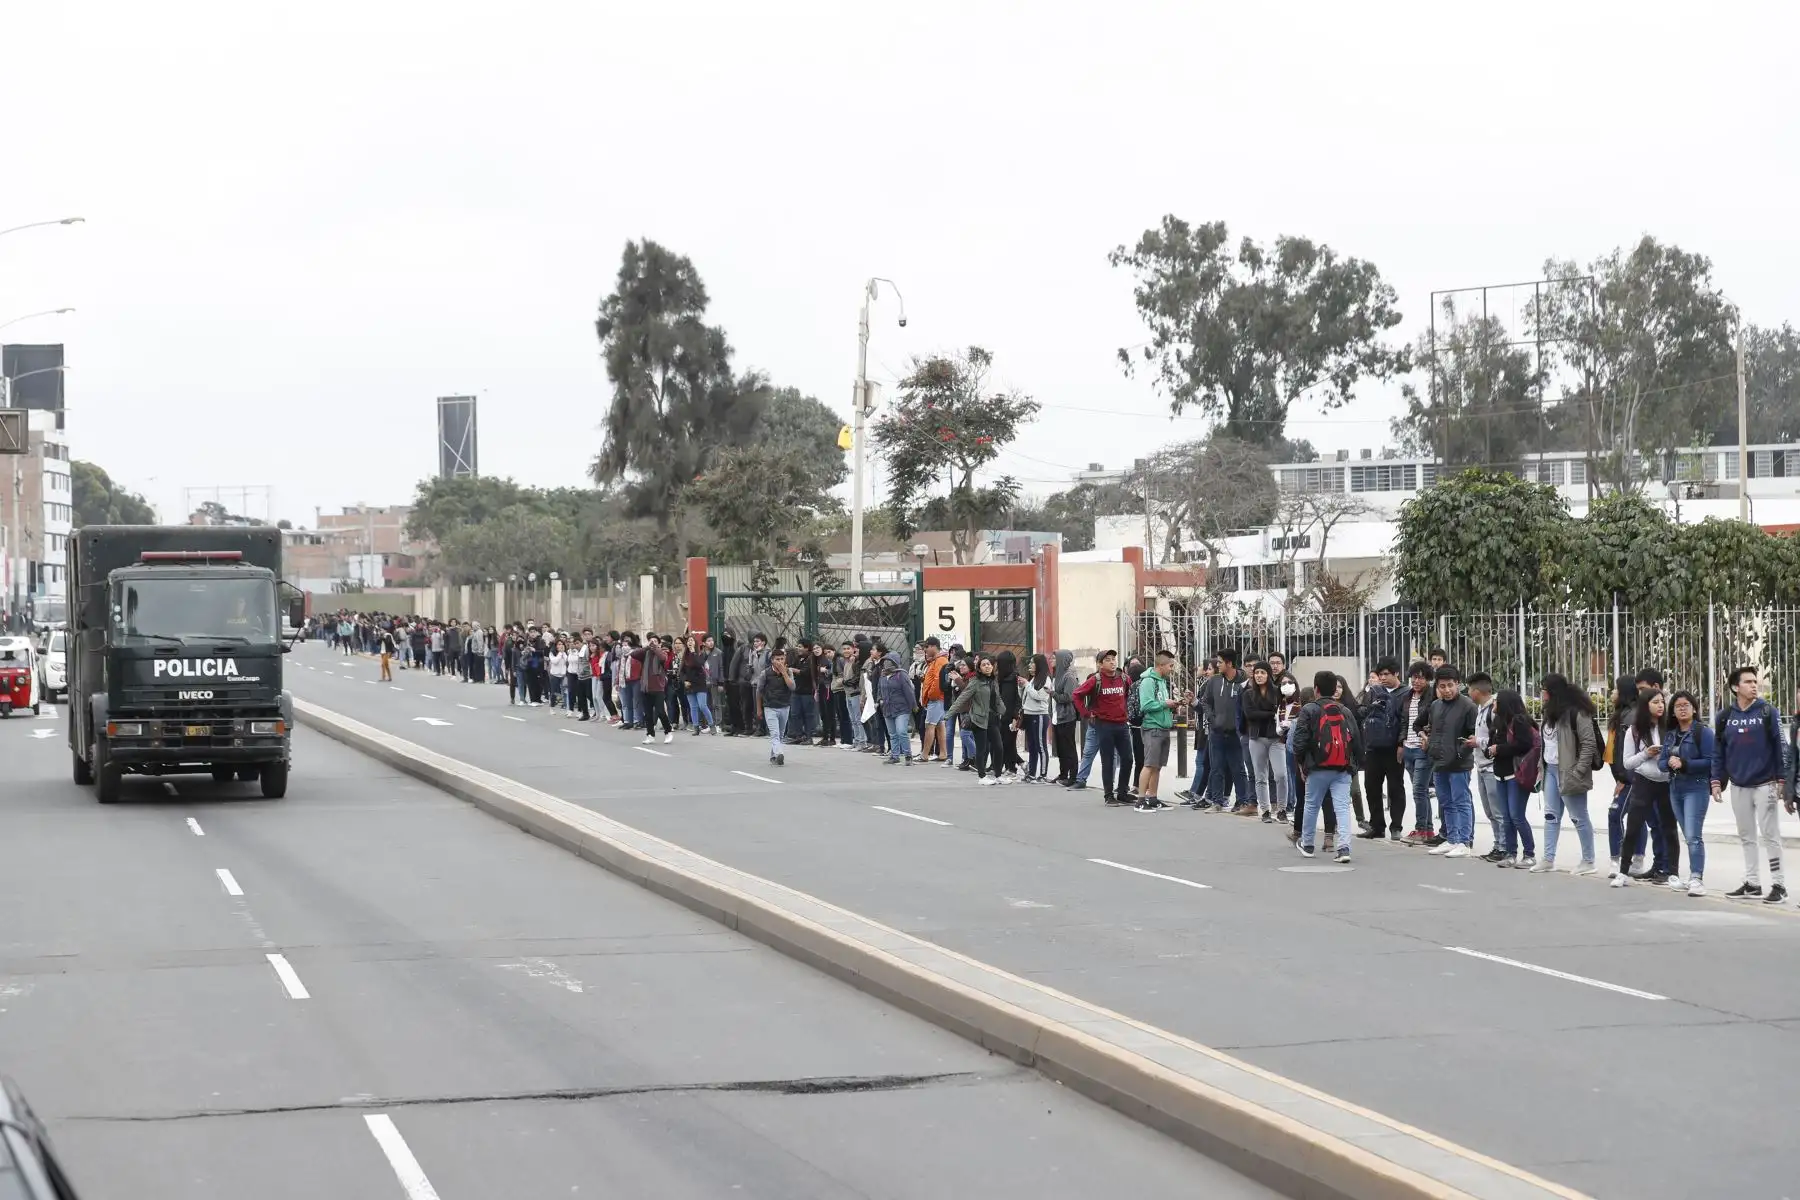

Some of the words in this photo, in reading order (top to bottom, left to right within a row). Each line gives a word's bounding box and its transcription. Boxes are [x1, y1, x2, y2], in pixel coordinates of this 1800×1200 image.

[939, 606, 955, 631] 5
[154, 658, 239, 677] POLICIA
[178, 691, 214, 700] IVECO
[1727, 717, 1763, 726] TOMMY
